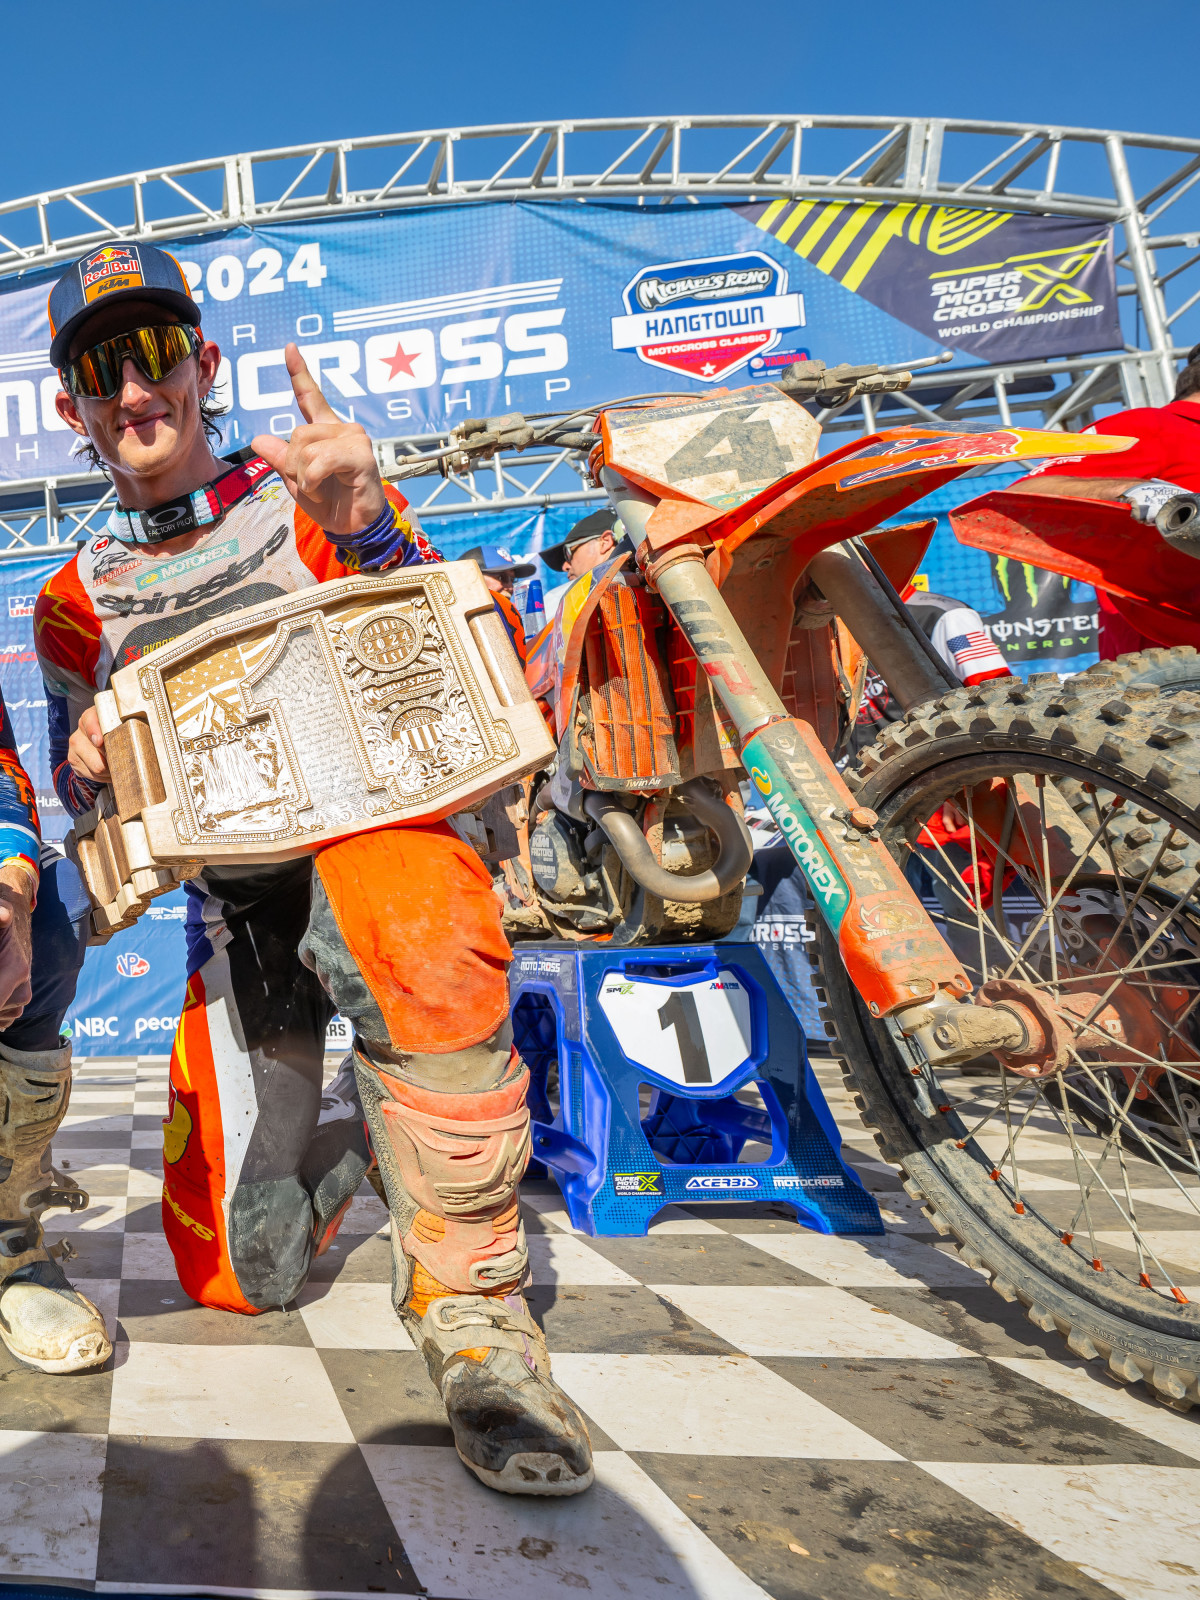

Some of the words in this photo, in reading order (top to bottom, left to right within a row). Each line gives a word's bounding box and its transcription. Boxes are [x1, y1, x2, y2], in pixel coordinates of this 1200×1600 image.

[83, 262, 111, 287] Red
[110, 259, 140, 274] Bull
[181, 242, 327, 304] 2024
[725, 270, 770, 288] RENO
[930, 270, 1023, 297] SUPER
[97, 278, 130, 294] KTM
[937, 284, 1021, 309] MOTO
[932, 296, 1024, 322] CROSS
[938, 322, 990, 338] WORLD
[992, 304, 1105, 330] CHAMPIONSHIP
[646, 306, 765, 338] HANGTOWN
[648, 340, 718, 357] MOTOCROSS
[719, 333, 768, 348] CLASSIC
[763, 352, 808, 367] YAMAHA
[663, 405, 795, 484] 4
[148, 522, 177, 537] FACTORY
[176, 515, 195, 529] PILOT
[161, 544, 231, 579] MOTOREX
[368, 619, 398, 637] JUNE
[984, 613, 1099, 642] ONSTE
[363, 630, 411, 654] 2024
[998, 636, 1090, 652] NERGY
[405, 716, 432, 730] NORTH
[625, 779, 648, 788] Twin
[647, 777, 663, 787] Air
[767, 790, 845, 905] MOTOREX
[520, 961, 561, 973] MOTOCROSS
[75, 1017, 119, 1038] NBC
[656, 991, 713, 1084] 1
[687, 1176, 759, 1188] ACERBIS
[773, 1178, 845, 1187] MOTOCROSS
